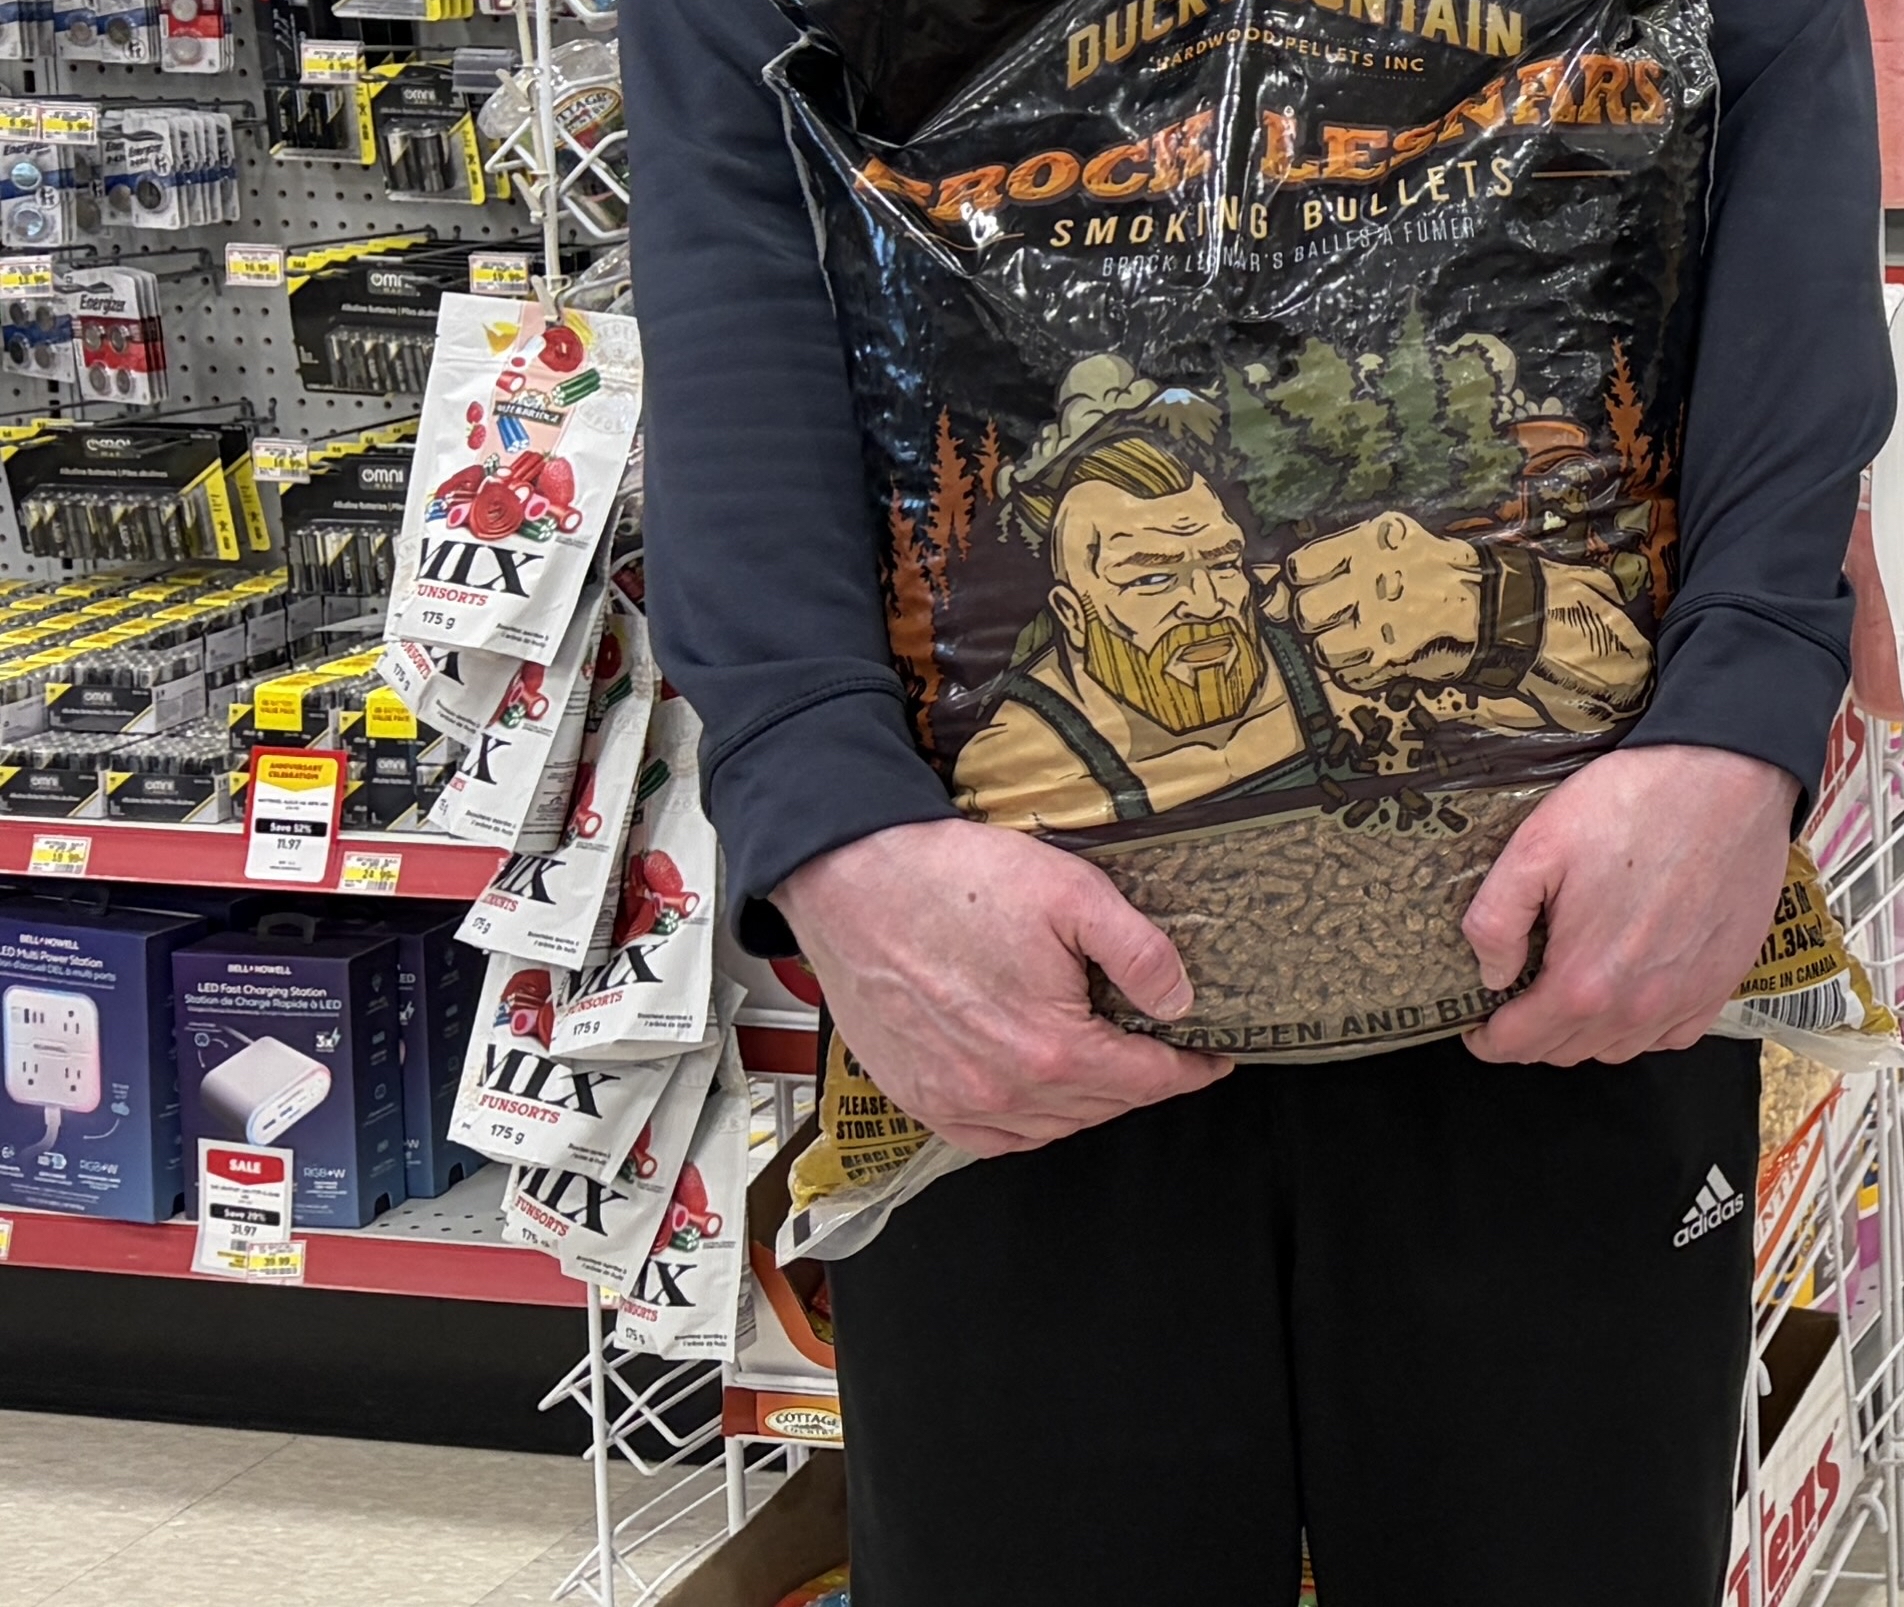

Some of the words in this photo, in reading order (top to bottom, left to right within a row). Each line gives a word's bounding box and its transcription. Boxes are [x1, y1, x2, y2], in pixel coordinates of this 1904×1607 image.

[1284, 36, 1375, 68] PELLETS
[1384, 55, 1425, 73] INC
[1050, 193, 1269, 249] SMOKING
[1303, 157, 1513, 225] BULLETS
[1401, 217, 1477, 245] FUMER
[422, 610, 444, 625] 175
[69, 954, 104, 969] Station
[1739, 976, 1776, 994] MADE
[1780, 971, 1793, 988] IN
[1796, 954, 1838, 983] CANADA
[184, 994, 219, 1006] Station
[235, 997, 270, 1010] Charge
[272, 997, 308, 1011] Rapide
[319, 998, 342, 1010] LED
[197, 982, 219, 994] LED
[220, 984, 241, 995] Fast
[243, 984, 288, 997] Charging
[290, 986, 327, 998] Station
[1186, 1020, 1324, 1049] ASPEN
[1340, 1005, 1421, 1039] AND
[479, 1094, 561, 1125] FUNSORTS
[838, 1095, 889, 1116] PLEASE
[490, 1122, 512, 1142] 175
[836, 1119, 886, 1140] STORE
[890, 1116, 908, 1135] IN
[229, 1159, 262, 1175] SALE
[514, 1195, 569, 1238] FUNSORTS
[1671, 1191, 1745, 1249] adidas
